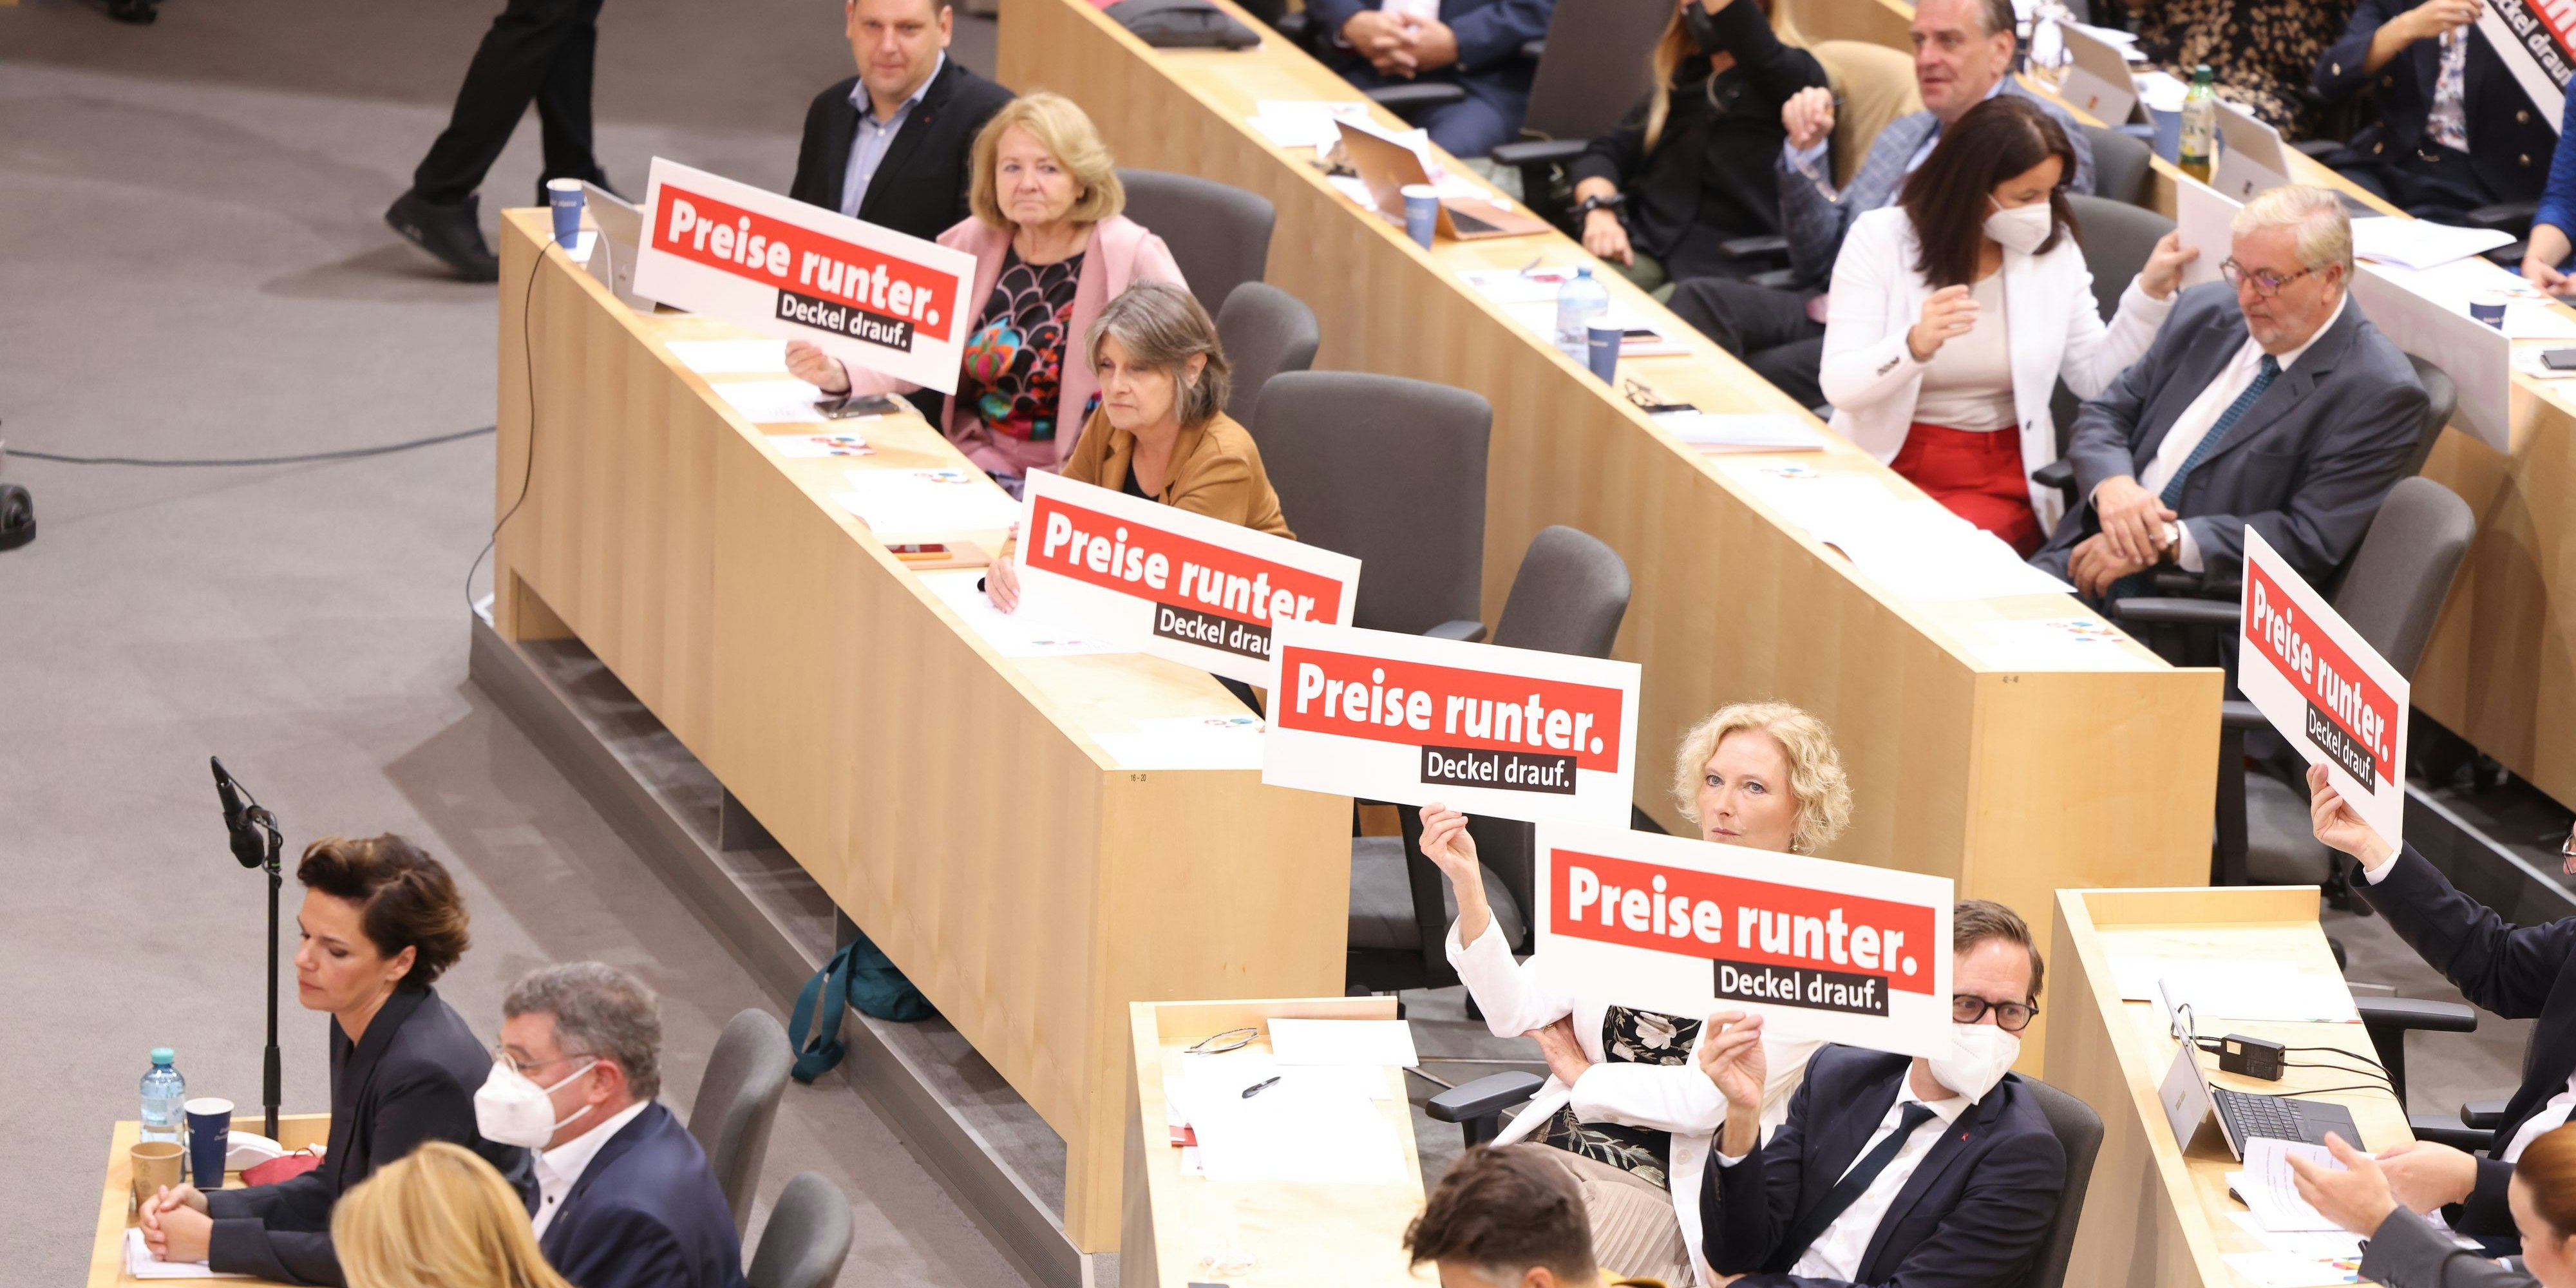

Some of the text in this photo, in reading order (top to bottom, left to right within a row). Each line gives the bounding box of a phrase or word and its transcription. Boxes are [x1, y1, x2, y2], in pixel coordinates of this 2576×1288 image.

[2494, 0, 2539, 37] ckel
[2528, 33, 2573, 86] drauf
[668, 198, 940, 328] Preise runter.
[781, 294, 907, 348] Deckel drauf.
[1043, 511, 1170, 590] Preise
[1160, 608, 1270, 656] Deckel drau
[2253, 578, 2389, 762] Preise runter.
[1296, 662, 1604, 755] Preise runter.
[2309, 707, 2372, 786] Deckel drauf.
[1428, 752, 1569, 788] Deckel drauf.
[1569, 866, 1918, 976] Preise runter.
[1721, 965, 1882, 1010] Deckel drauf.
